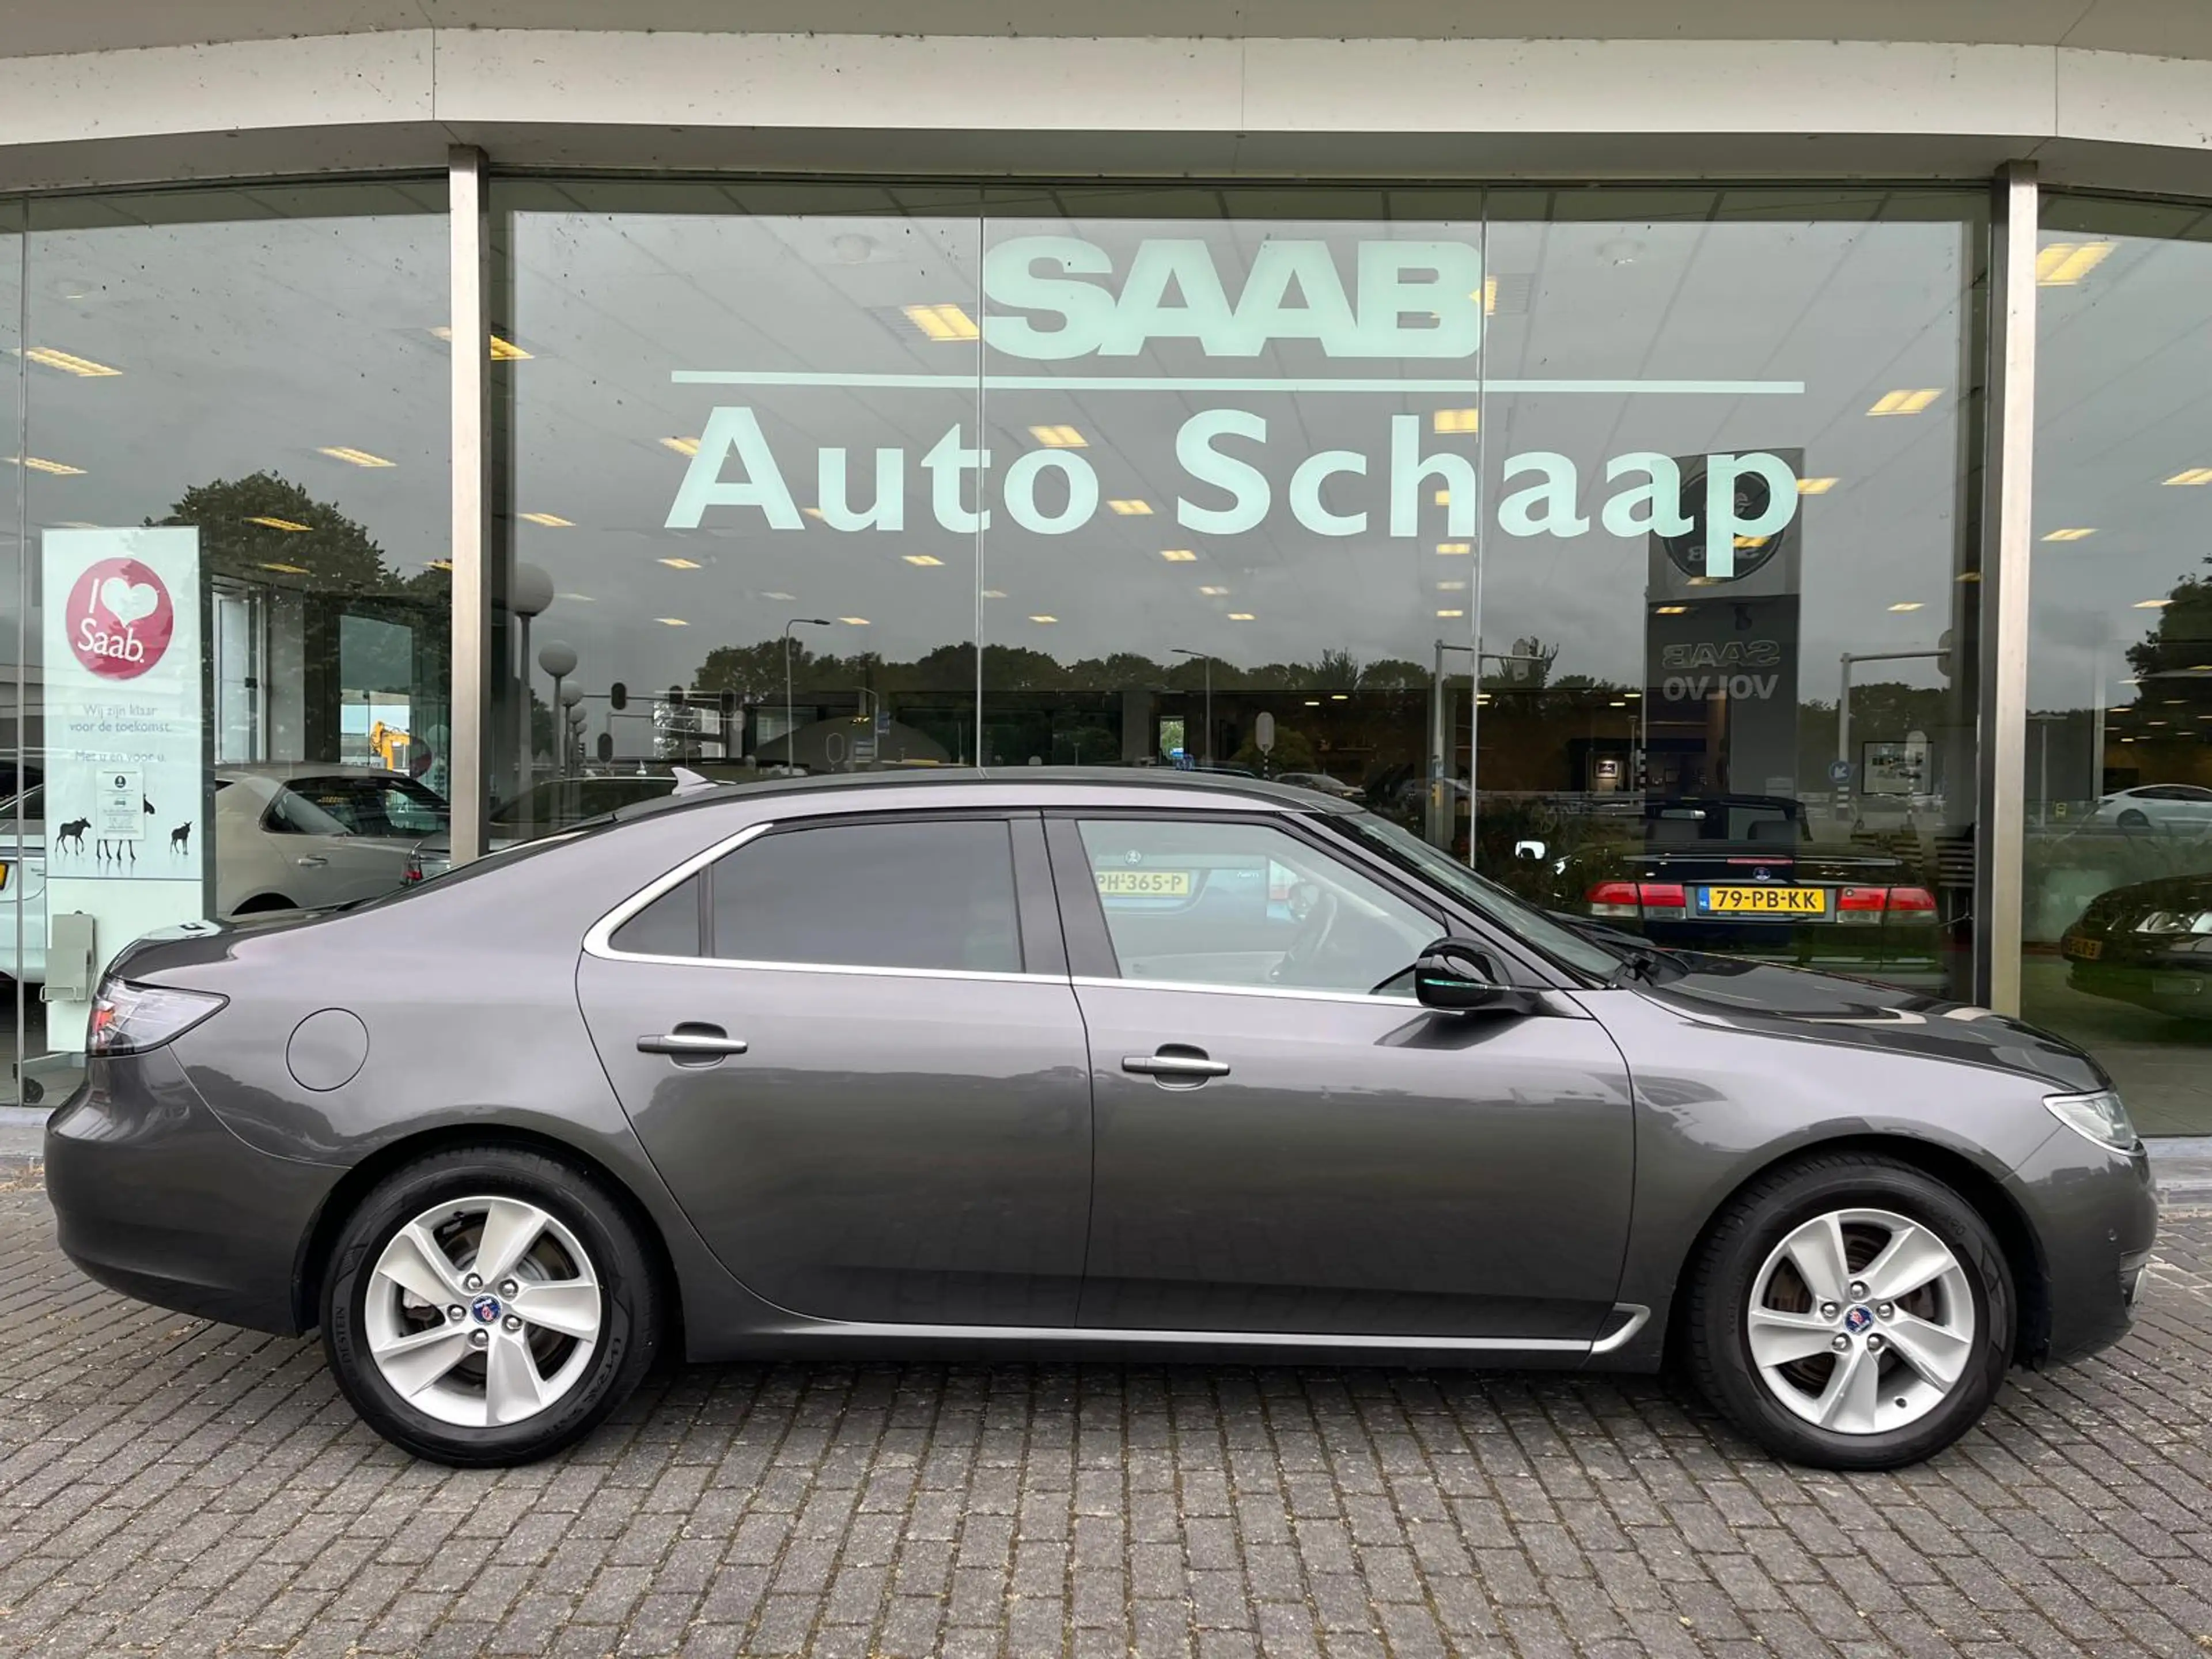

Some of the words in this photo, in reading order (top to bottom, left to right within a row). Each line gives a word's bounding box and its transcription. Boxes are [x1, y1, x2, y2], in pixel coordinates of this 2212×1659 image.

[983, 236, 1481, 360] SAAB
[664, 406, 1099, 535] Auto
[1175, 408, 1799, 577] Schaap
[89, 578, 100, 613] I
[77, 618, 145, 664] Saab.
[69, 722, 94, 732] voor
[99, 720, 112, 732] de
[1716, 890, 1816, 909] 79-PB-KK
